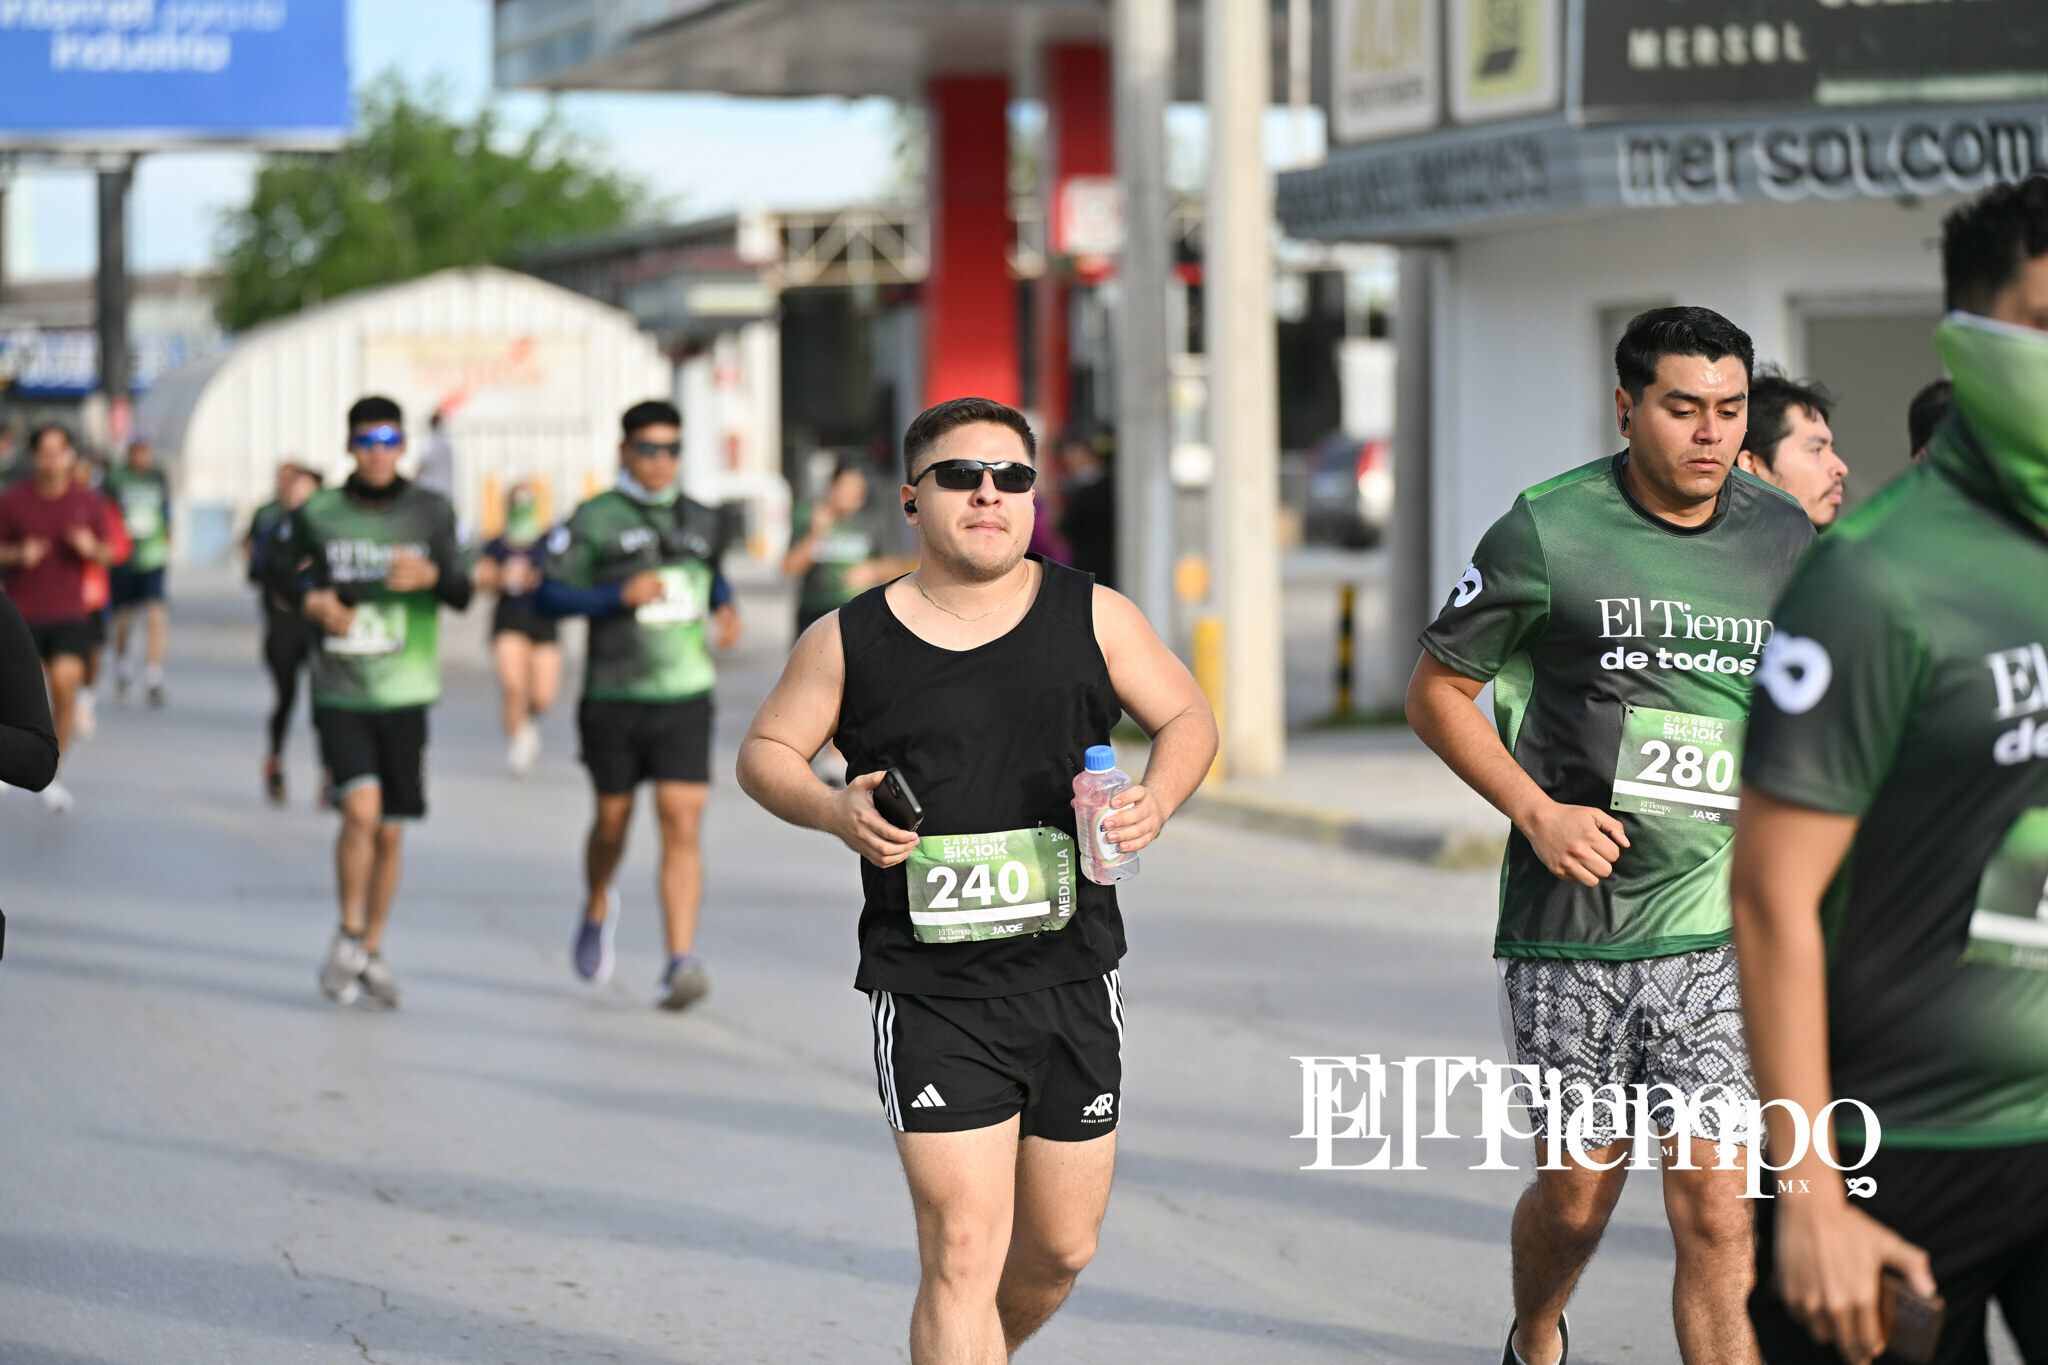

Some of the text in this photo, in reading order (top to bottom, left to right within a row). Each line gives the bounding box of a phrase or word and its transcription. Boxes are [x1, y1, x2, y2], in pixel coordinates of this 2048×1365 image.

[1628, 20, 1808, 70] MERSOL
[1595, 597, 1774, 655] El Tiemp
[1600, 646, 1757, 676] de todos
[1664, 714, 1724, 730] CARRERA
[1635, 740, 1735, 792] 280
[943, 834, 1007, 846] CARRERA
[926, 860, 1029, 909] 240
[1057, 848, 1070, 917] MEDALLA
